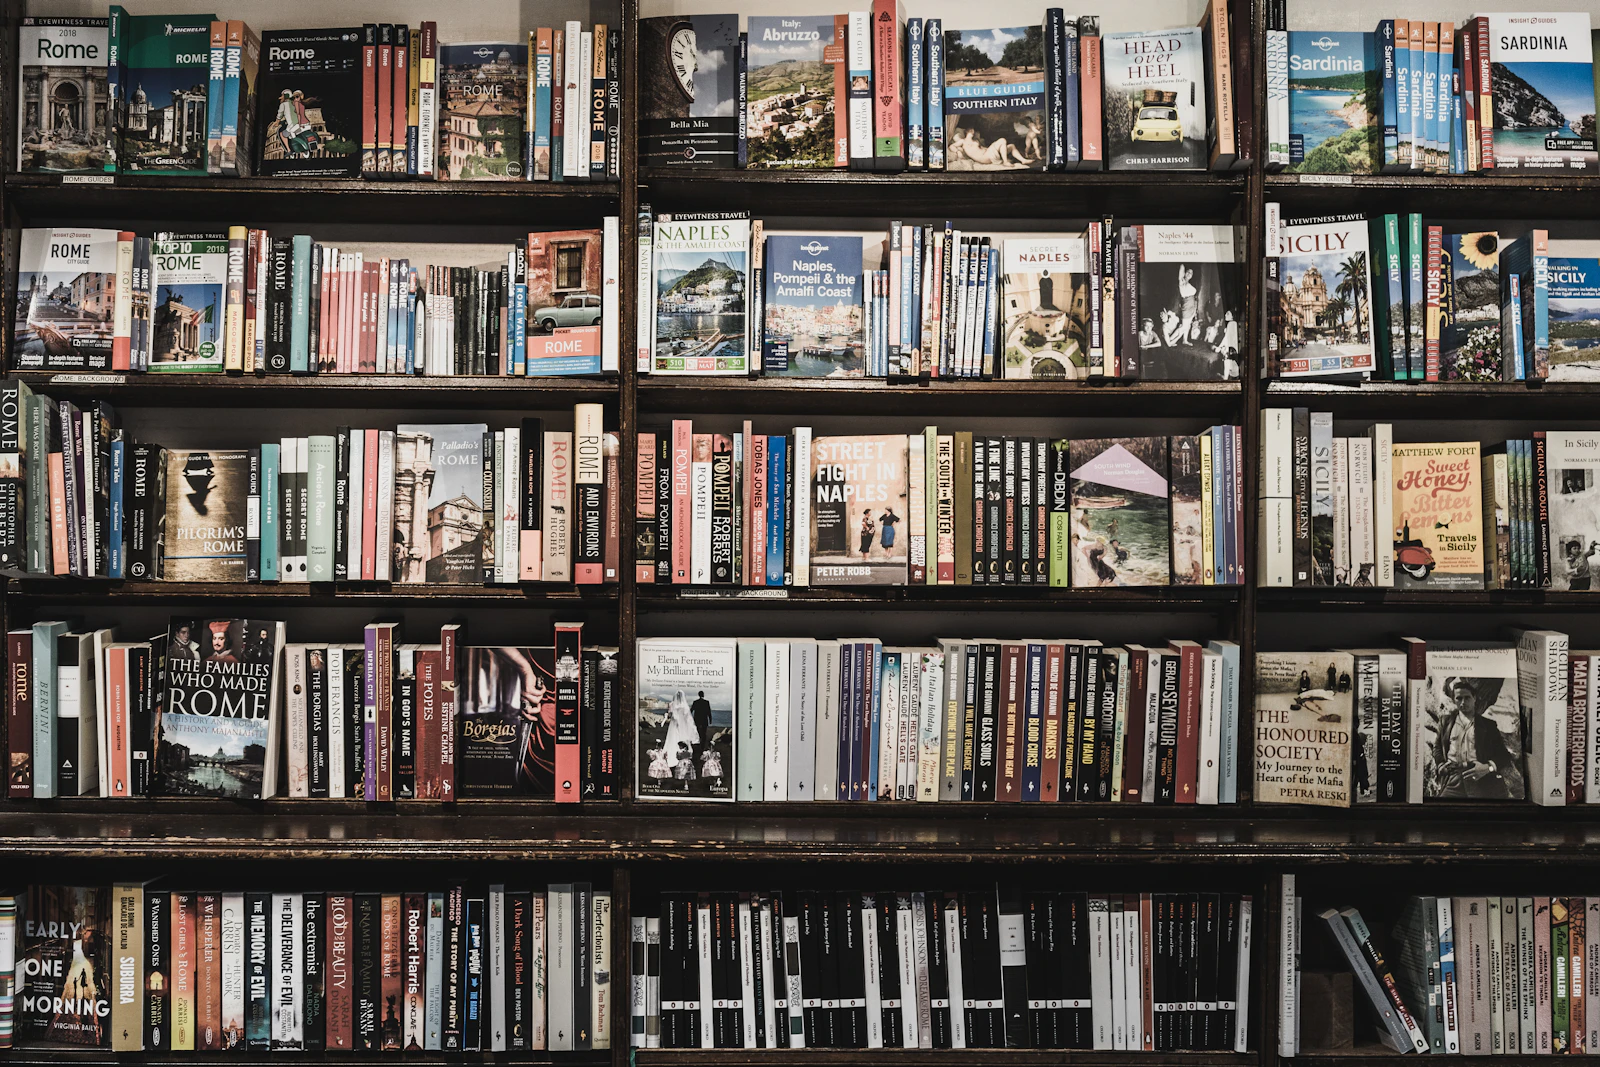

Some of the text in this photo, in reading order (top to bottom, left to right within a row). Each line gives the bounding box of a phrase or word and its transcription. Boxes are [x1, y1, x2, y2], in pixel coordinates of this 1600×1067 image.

[59, 29, 76, 37] 2018
[782, 20, 801, 28] Italy:
[763, 29, 820, 42] Abruzzo
[1501, 36, 1568, 50] SARDINIA
[38, 39, 98, 59] Rome
[269, 47, 314, 60] Rome
[1125, 39, 1181, 54] HEAD
[176, 54, 207, 63] ROME
[1135, 53, 1173, 64] over
[1290, 55, 1363, 71] Sardinia
[537, 57, 550, 87] ROME
[911, 44, 920, 105] Southern Italy
[1128, 64, 1180, 78] HEEL
[463, 85, 503, 96] ROME
[959, 85, 1032, 96] BLUE GUIDE
[953, 97, 1037, 110] SOUTHERN ITALY
[86, 176, 112, 184] GUIDES
[1290, 215, 1335, 225] EYEWITNESS
[658, 225, 730, 241] NAPLES
[51, 245, 90, 258] ROME
[206, 245, 225, 253] 2018
[1020, 254, 1070, 262] NAPLES
[157, 257, 201, 270] ROME
[229, 247, 243, 283] ROME
[275, 253, 285, 290] ROME
[793, 261, 836, 272] Naples,
[1390, 255, 1399, 282] SICILY
[773, 273, 855, 285] Pompeii & the
[1535, 258, 1547, 289] SICILY
[776, 286, 851, 297] Amalfi Coast
[545, 341, 582, 353] ROME
[1, 389, 17, 448] ROME
[438, 455, 478, 465] ROME
[754, 440, 762, 474] TOBIAS
[817, 442, 885, 461] STREET
[551, 440, 568, 501] ROME
[817, 463, 895, 481] FIGHT IN
[1426, 459, 1470, 474] Sweet
[134, 459, 146, 497] ROME
[1314, 447, 1329, 507] SICILY
[1537, 441, 1547, 521] SICILIAN CAROUSEL
[337, 479, 346, 505] Rome
[817, 484, 888, 502] NAPLES
[660, 469, 669, 550] FROM POMPEII
[587, 487, 598, 557] AND ENVIRONS
[177, 526, 244, 539] PILGRIM'S
[713, 516, 722, 563] HARRIS
[722, 516, 730, 563] ROBERT
[1437, 534, 1477, 542] Travels
[204, 541, 243, 552] ROME
[817, 567, 871, 577] PETER ROBB
[170, 659, 269, 677] THE FAMILIES
[658, 656, 713, 665] Elena Ferrante
[647, 665, 724, 676] My Brilliant Friend
[1549, 641, 1557, 701] SHADOWS
[1558, 641, 1568, 701] SICILIAN
[17, 663, 27, 701] rome
[170, 672, 267, 691] WHO MADE
[331, 653, 340, 735] POPE FRANCIS
[40, 681, 48, 734] BERNINI
[168, 688, 267, 720] ROME
[402, 686, 410, 756] IN GOD'S NAME
[1257, 710, 1289, 723] THE
[1381, 698, 1390, 740] BATTLE
[1392, 684, 1401, 755] THE DAY OF
[1572, 661, 1587, 787] MAFIA BROTHERHOODS
[981, 718, 993, 766] GLASS SOULS
[1257, 728, 1348, 745] HONOURED
[1256, 745, 1322, 760] SOCIETY
[1256, 761, 1272, 771] My
[1275, 762, 1313, 772] Journey
[1328, 765, 1342, 774] the
[1256, 773, 1343, 786] Heart of the Mafia
[1280, 788, 1347, 800] PETRA RESKI
[26, 920, 82, 939] EARLY
[152, 905, 160, 966] VANISHED ONES
[205, 904, 213, 962] WHISPERER
[306, 901, 320, 975] the extremist
[251, 901, 265, 1001] THE MEMORY OF EVIL
[281, 898, 293, 1007] THE DELIVERANCE OF EVIL
[408, 910, 419, 994] Robert Harris
[25, 959, 62, 977] ONE
[1557, 957, 1565, 997] CAMILLERI
[120, 957, 134, 1004] SUBURRA
[23, 996, 110, 1016] MORNING
